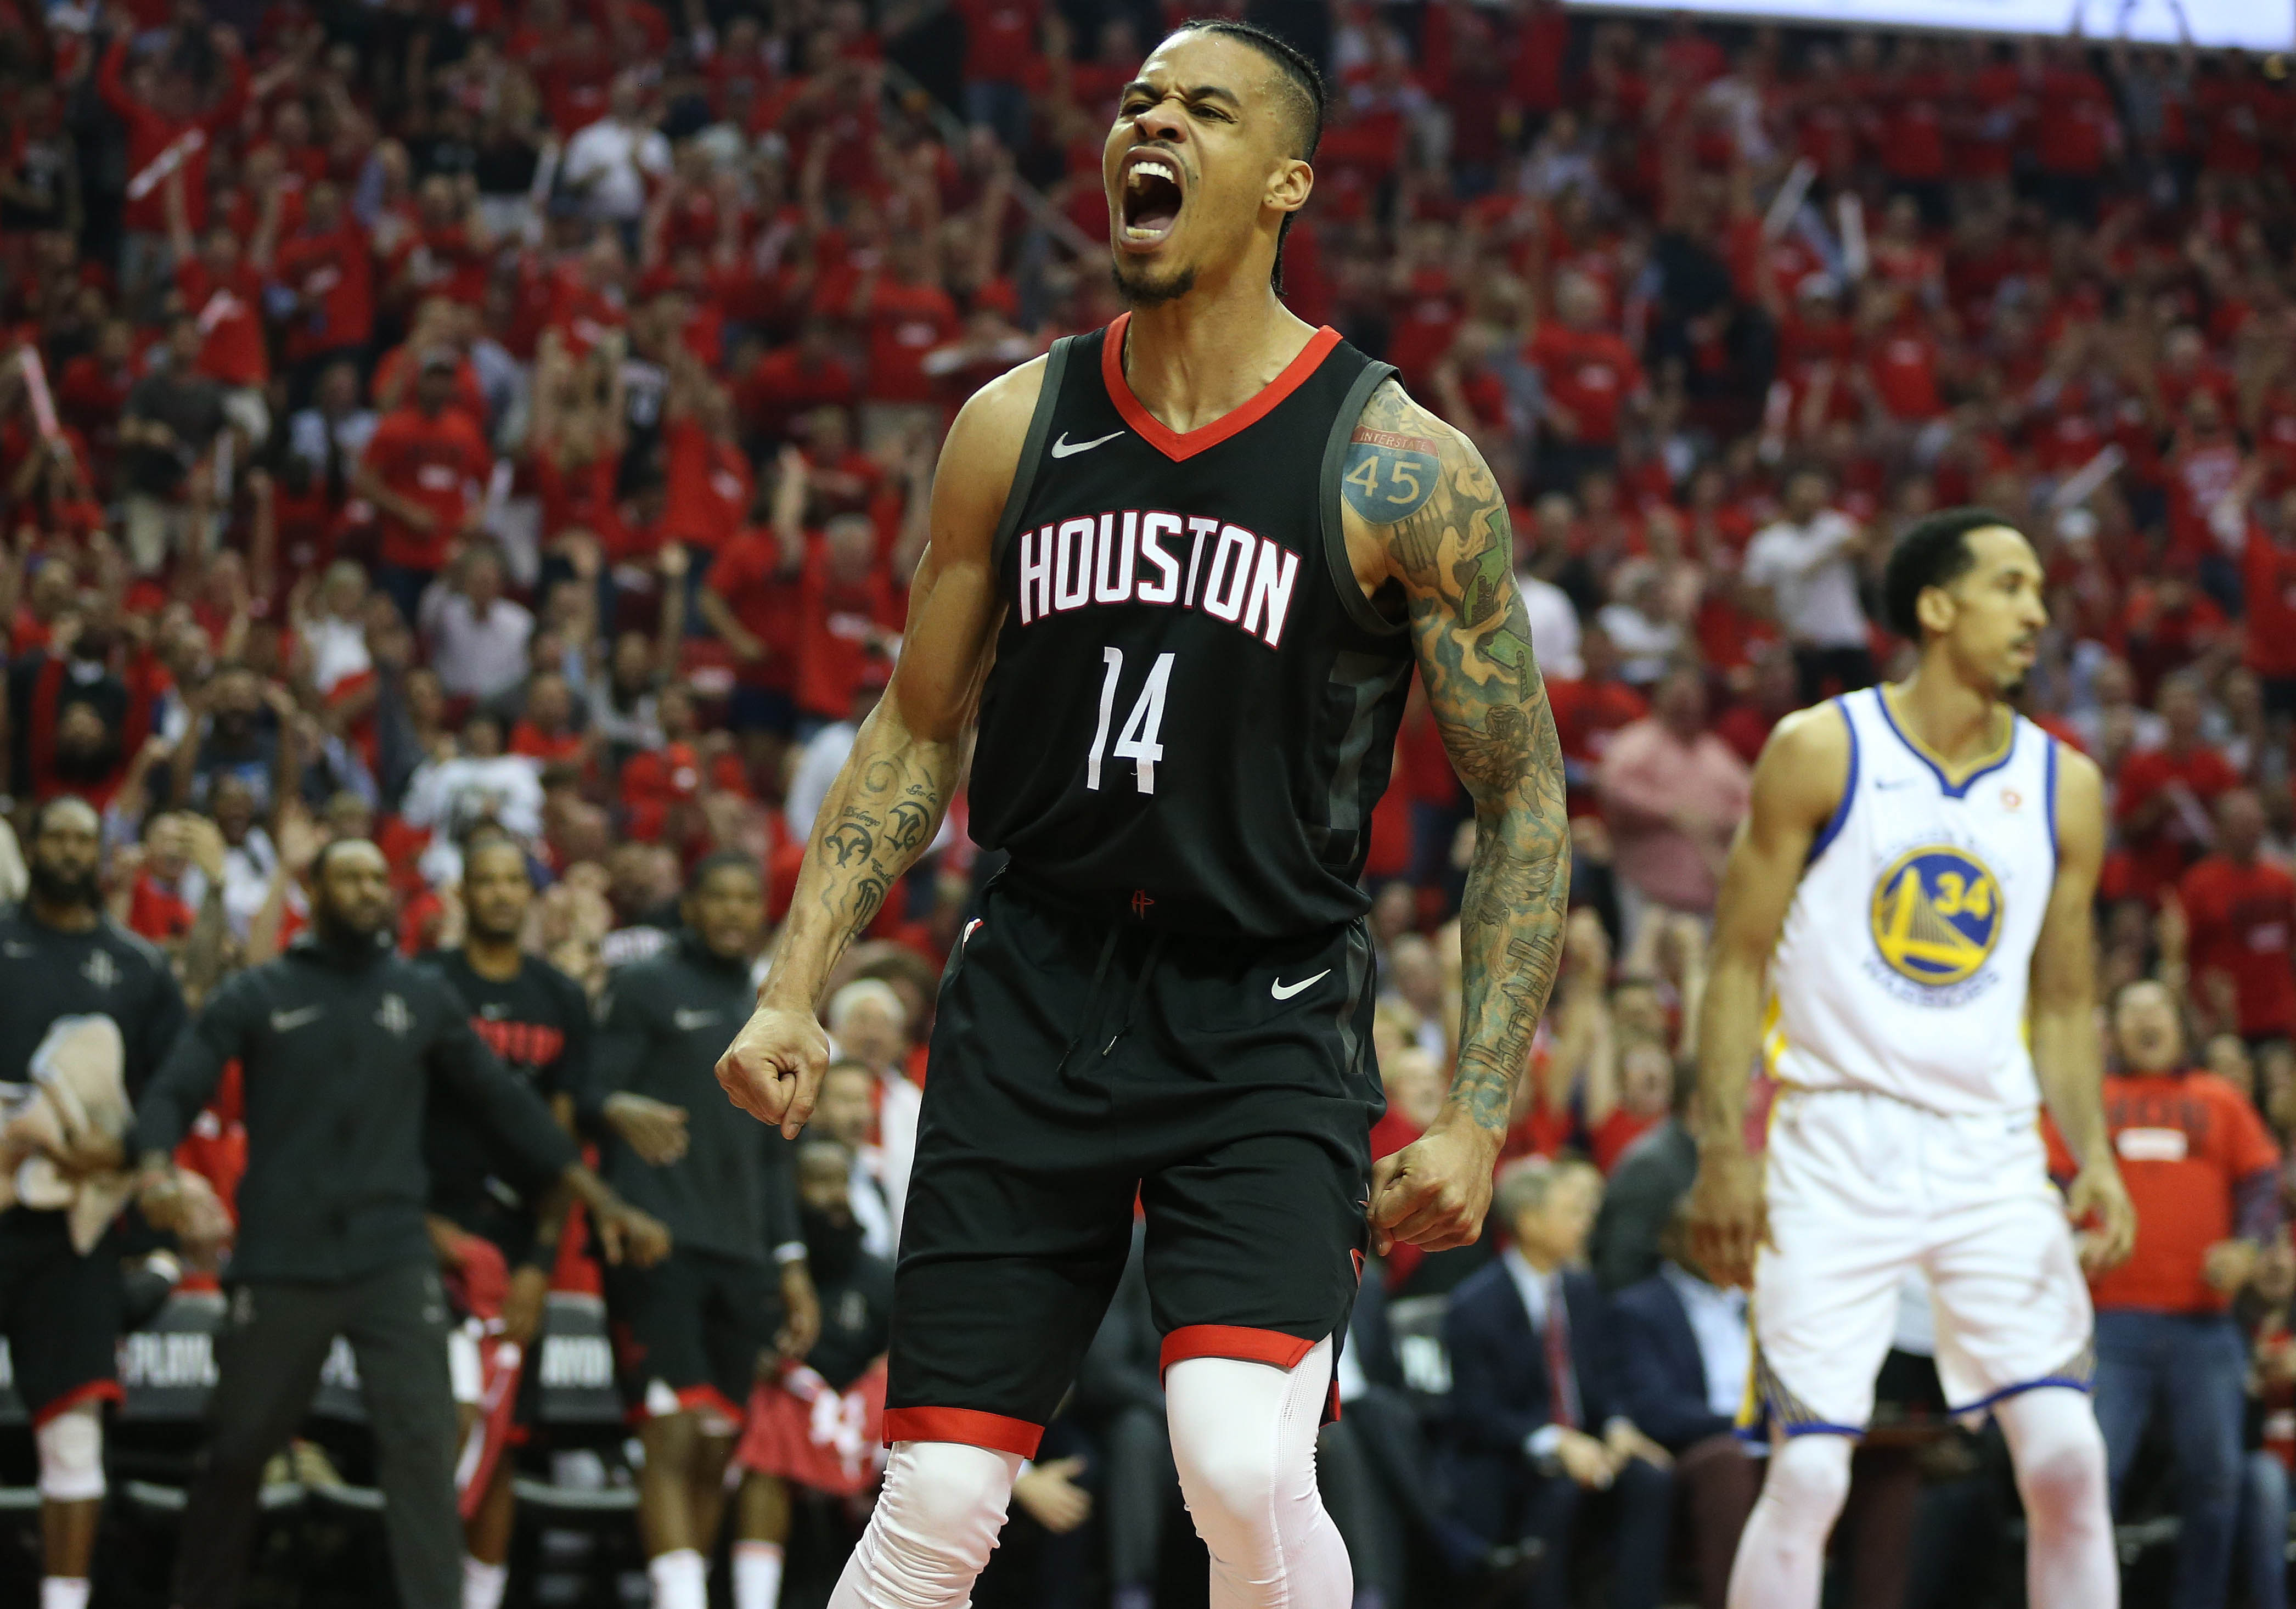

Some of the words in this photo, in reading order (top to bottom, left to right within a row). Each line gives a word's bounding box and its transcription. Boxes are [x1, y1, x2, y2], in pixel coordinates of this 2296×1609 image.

[1360, 431, 1428, 452] INTERSTATE
[1346, 454, 1422, 504] 45
[1020, 509, 1302, 651] HOUSTON
[1087, 646, 1175, 795] 14
[1933, 871, 1992, 921] 34
